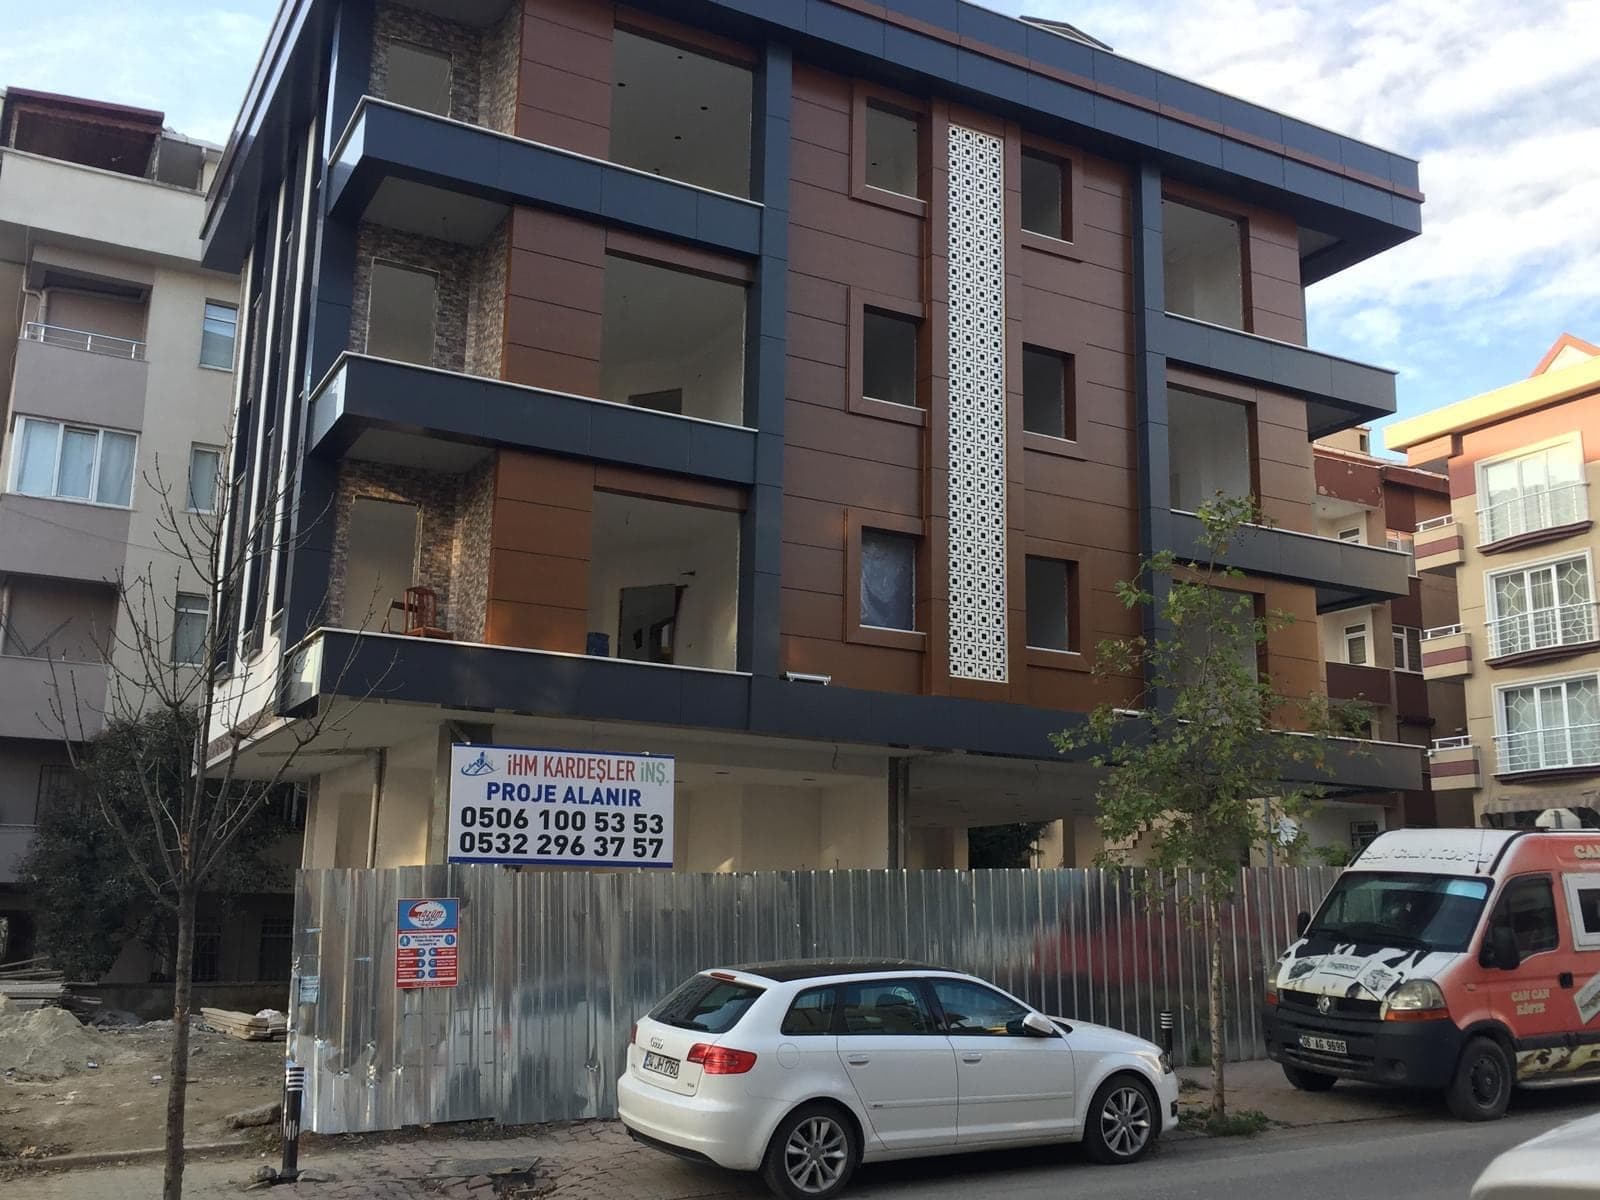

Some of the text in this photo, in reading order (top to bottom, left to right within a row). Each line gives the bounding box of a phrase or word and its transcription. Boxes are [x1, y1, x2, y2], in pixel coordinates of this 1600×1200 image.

[543, 756, 636, 783] KARDEŞLER
[486, 781, 642, 807] PROJE ALANIR
[460, 806, 664, 834] 0506 100 53 53
[459, 831, 664, 858] 0532 296 37 57
